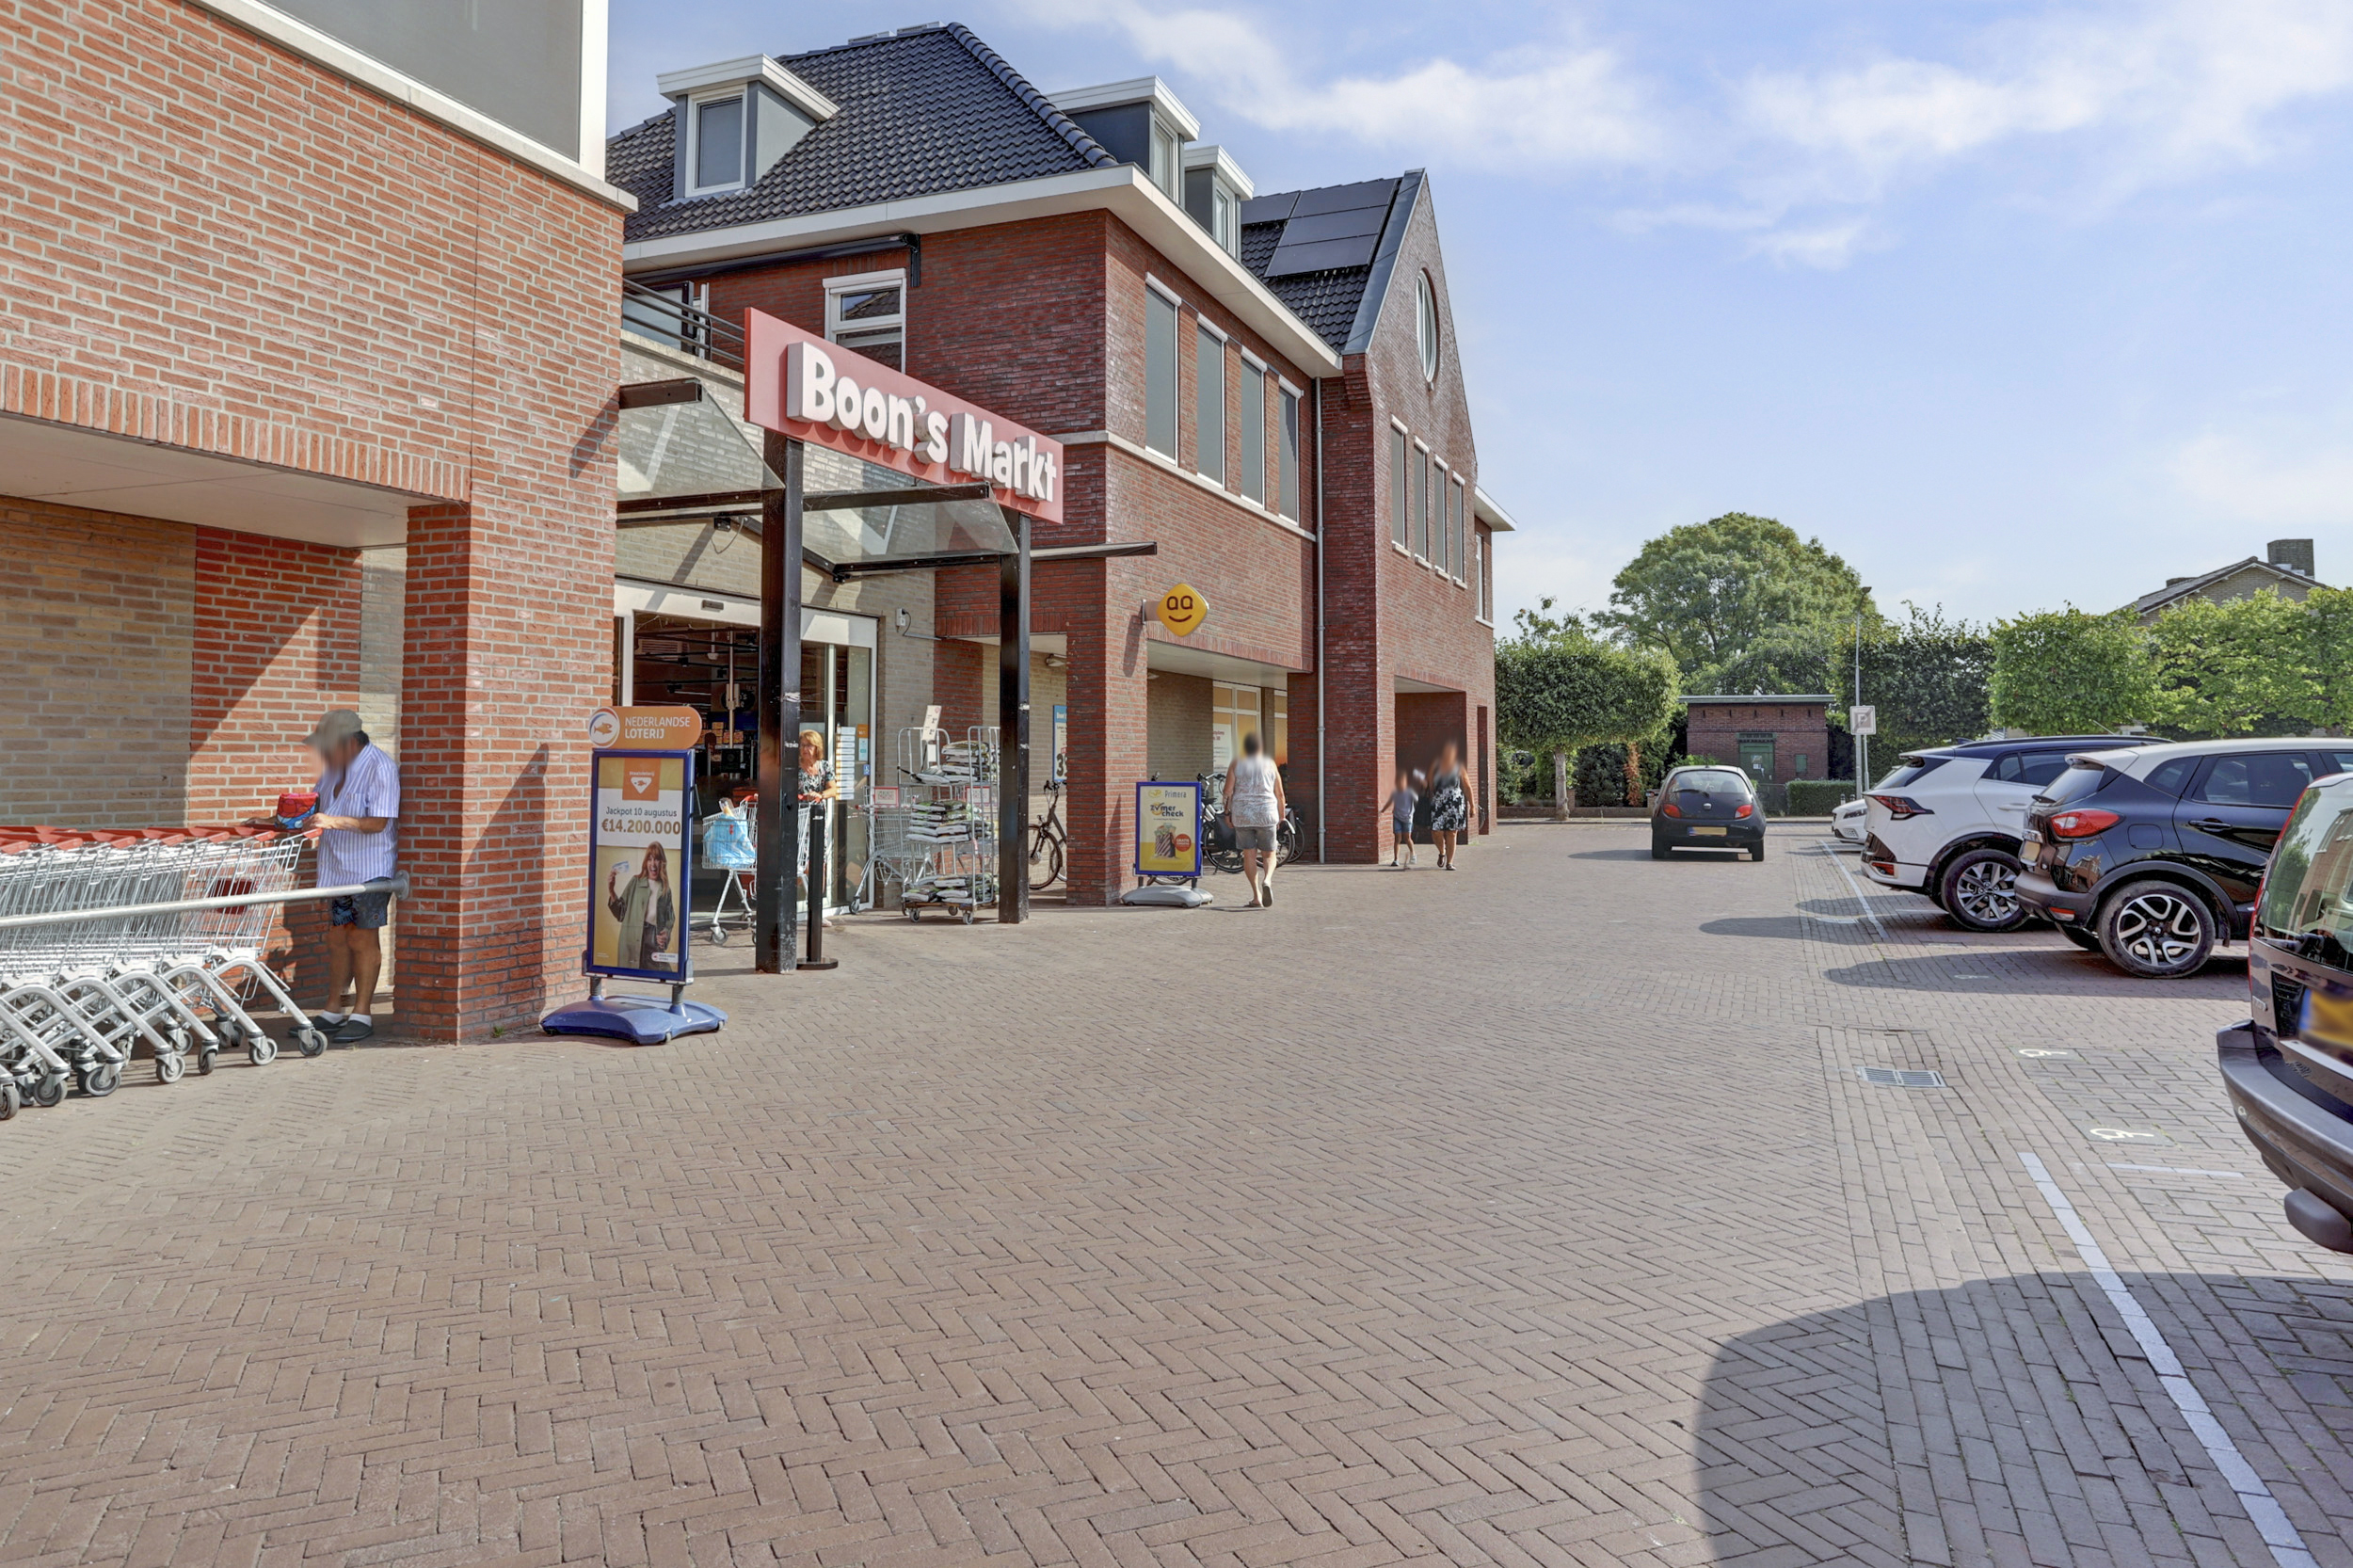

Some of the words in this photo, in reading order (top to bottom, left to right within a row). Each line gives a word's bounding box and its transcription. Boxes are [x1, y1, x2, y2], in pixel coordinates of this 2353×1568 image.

[789, 341, 949, 464] Boon's
[952, 411, 1058, 503] Markt
[625, 716, 691, 727] NEDERLANDSE
[625, 728, 664, 739] LOTERIJ
[1164, 790, 1187, 798] Primera
[605, 806, 632, 816] Jackpot
[634, 808, 643, 816] 10
[644, 809, 678, 818] augustus
[1161, 808, 1184, 817] check
[601, 819, 681, 835] €14.200.000
